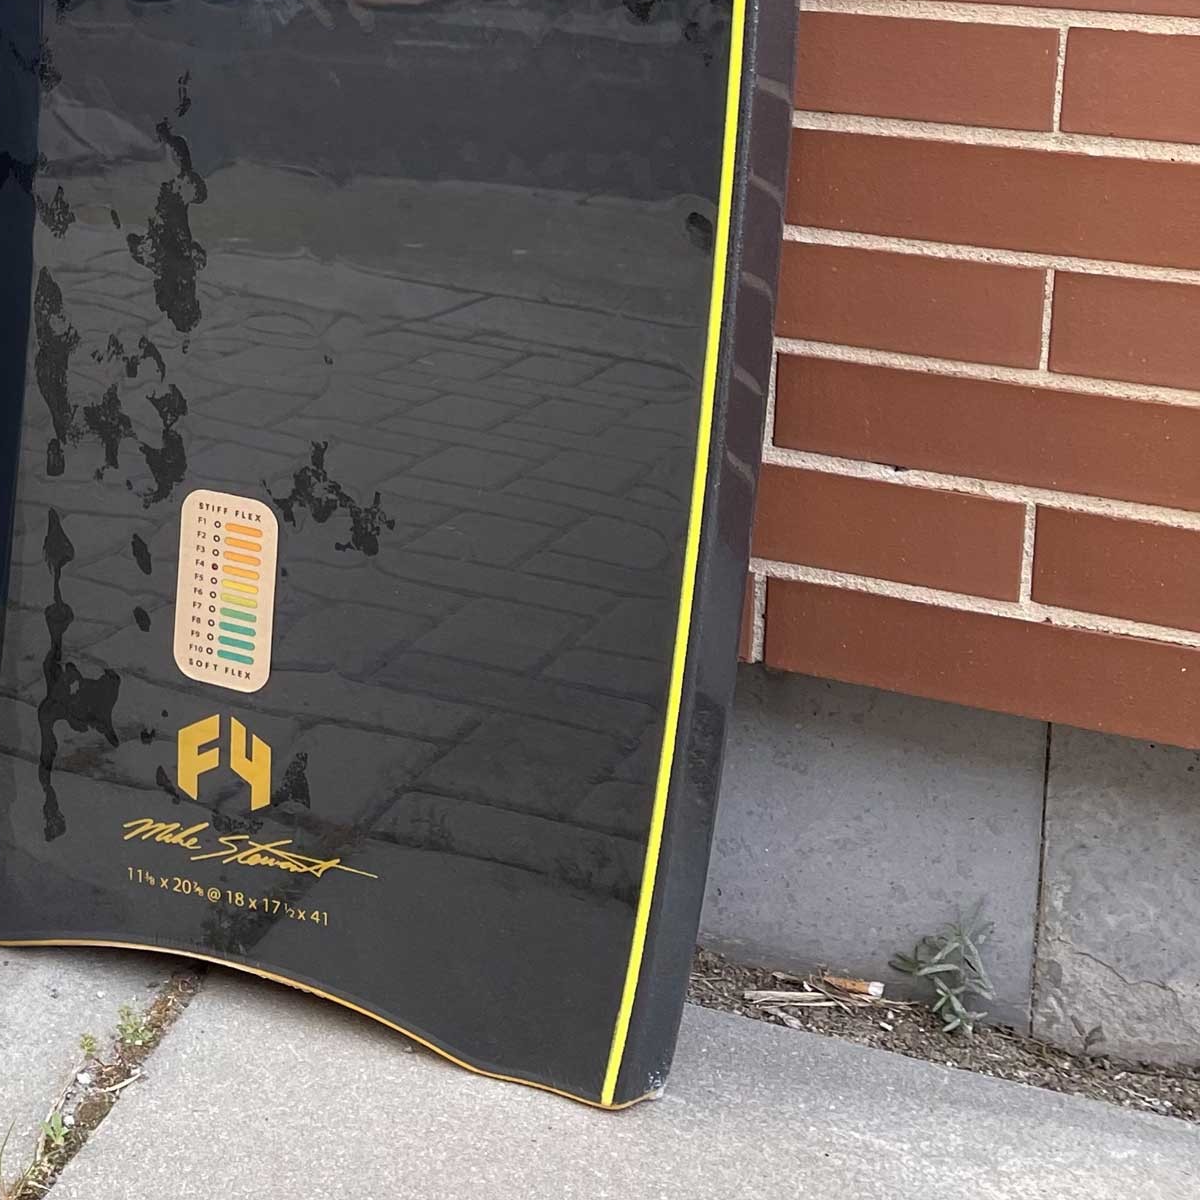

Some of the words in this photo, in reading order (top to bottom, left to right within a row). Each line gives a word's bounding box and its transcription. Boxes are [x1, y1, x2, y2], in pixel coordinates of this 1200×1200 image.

[199, 502, 228, 515] STIFF
[235, 510, 262, 522] FLEX
[198, 516, 207, 525] F1
[197, 531, 206, 539] F2
[196, 545, 205, 553] F3
[195, 559, 205, 567] F4
[194, 573, 204, 581] F5
[193, 587, 203, 596] F6
[192, 601, 202, 609] F7
[191, 615, 201, 624] F8
[190, 629, 200, 638] F9
[189, 643, 203, 653] F10
[189, 658, 218, 671] SOFT
[224, 666, 251, 680] FLEX
[177, 713, 272, 812] F4
[123, 817, 209, 850] Mike
[160, 877, 169, 889] x
[207, 887, 222, 902] @
[226, 890, 245, 907] 18
[248, 897, 257, 910] x
[310, 910, 328, 926] 41
